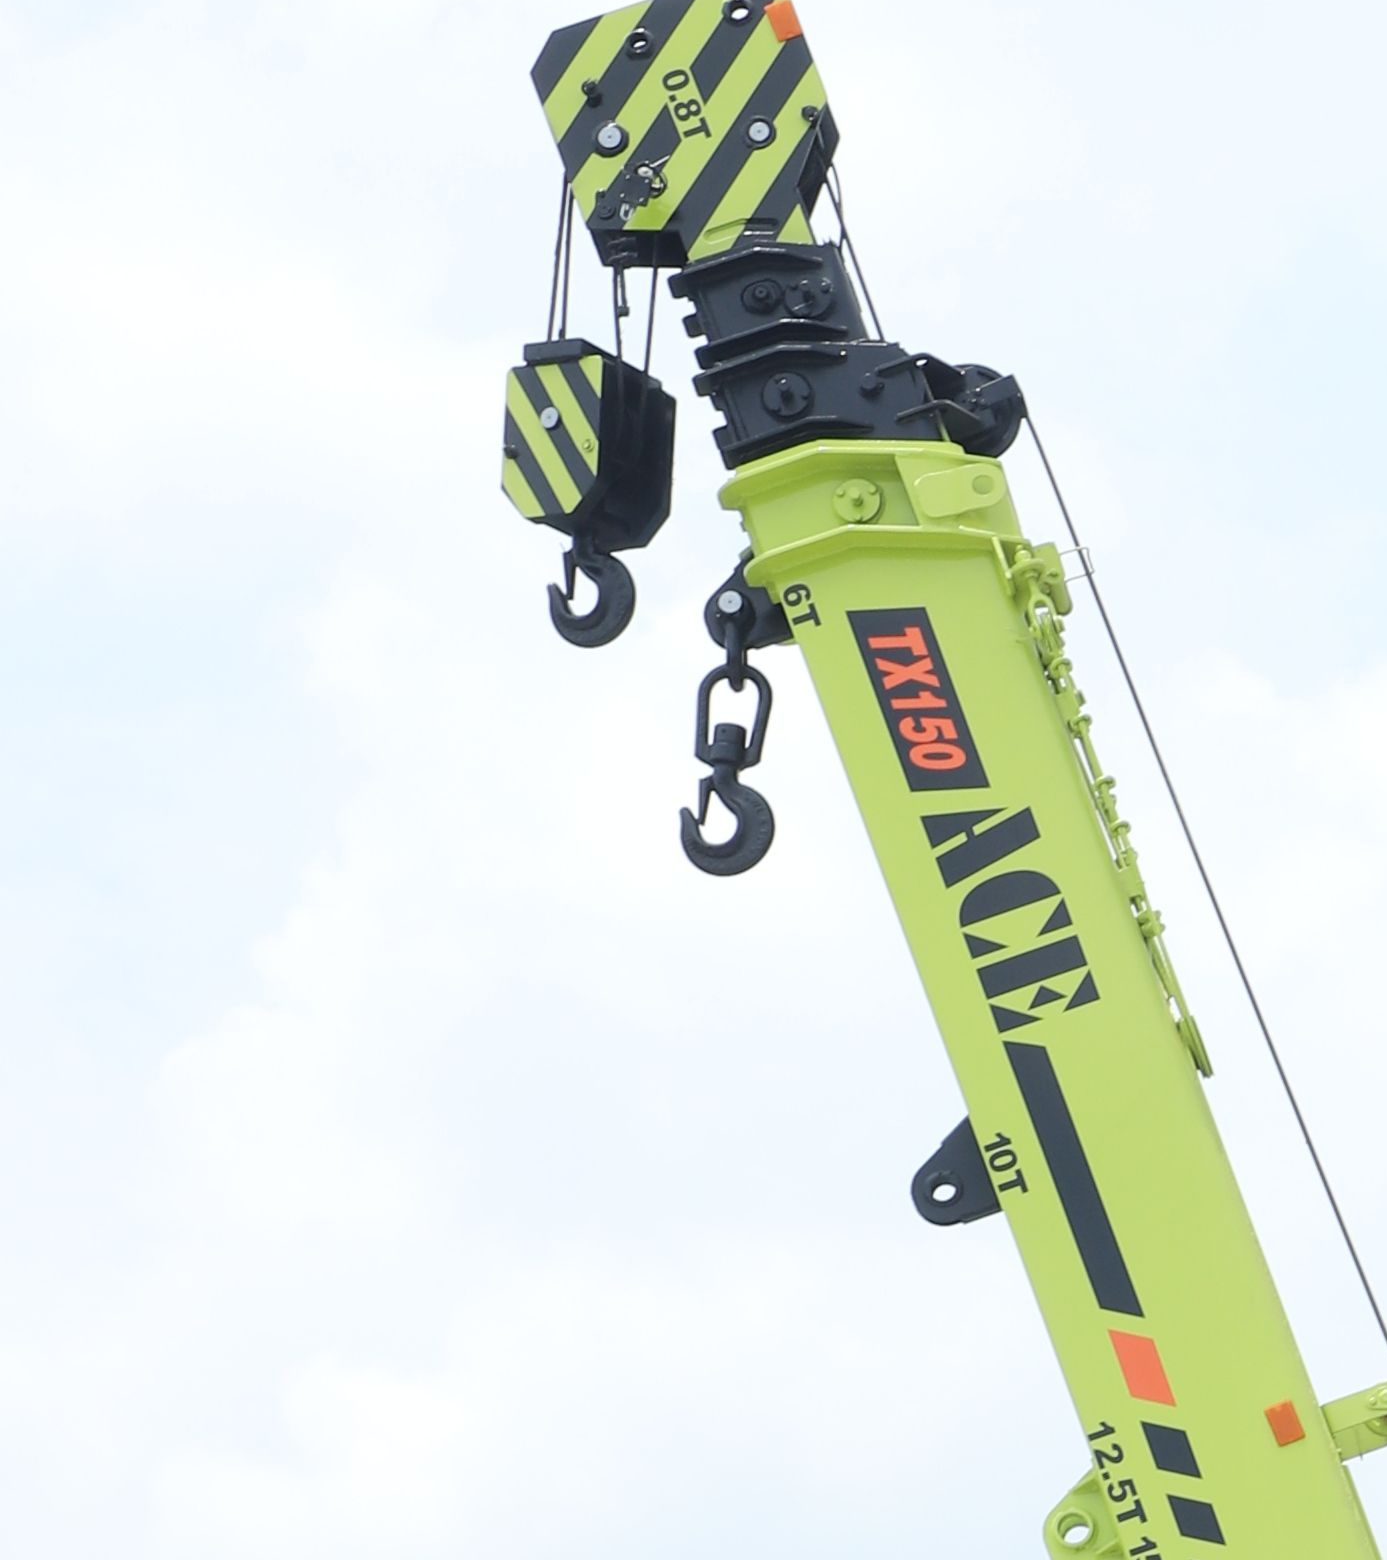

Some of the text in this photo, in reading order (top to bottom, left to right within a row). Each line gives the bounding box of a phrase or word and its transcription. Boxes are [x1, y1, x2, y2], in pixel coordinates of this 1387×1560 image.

[662, 69, 712, 138] 0.8T
[782, 583, 822, 628] 6T
[867, 626, 967, 771] TX150
[920, 806, 1101, 1034] ACE
[983, 1132, 1029, 1196] 10T
[1086, 1421, 1148, 1524] 12.5T
